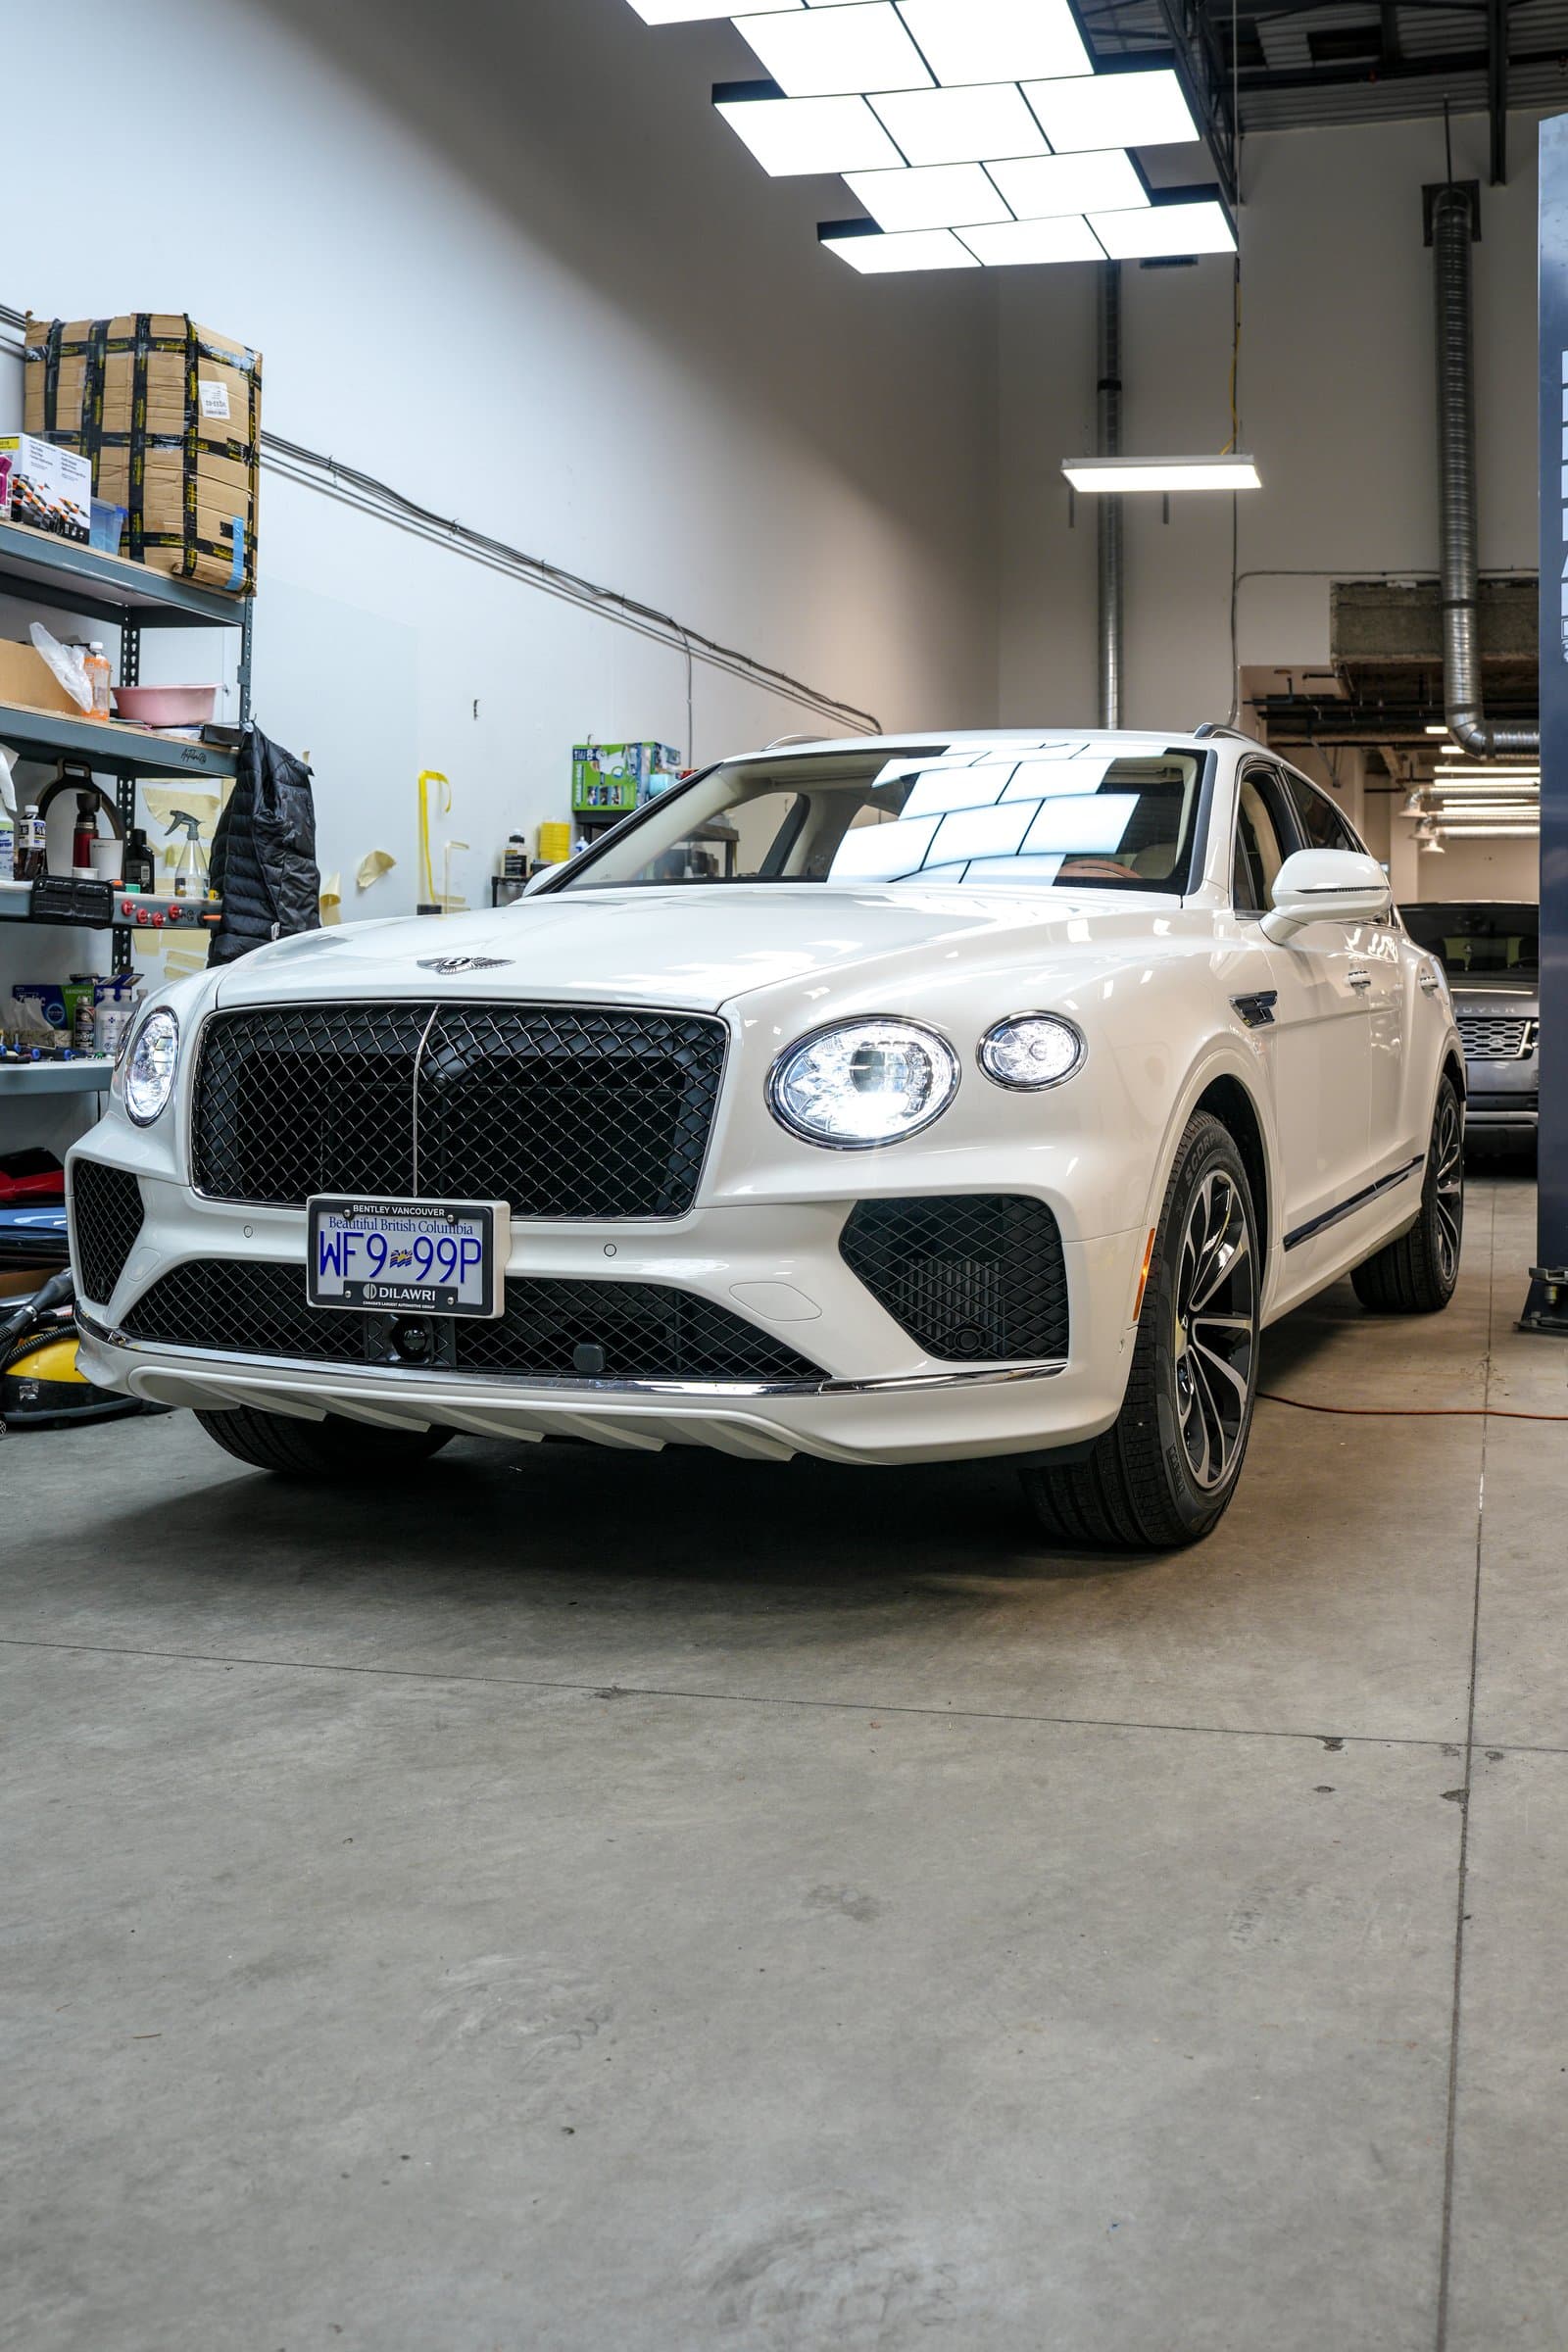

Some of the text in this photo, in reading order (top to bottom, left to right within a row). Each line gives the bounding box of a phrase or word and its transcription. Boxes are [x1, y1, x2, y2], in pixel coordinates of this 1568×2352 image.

[353, 1204, 445, 1216] BENTLEY VANCOUVER
[329, 1216, 473, 1235] Beautiful British Columbia
[319, 1230, 482, 1284] WF9 99P
[379, 1287, 436, 1301] DILAWRI
